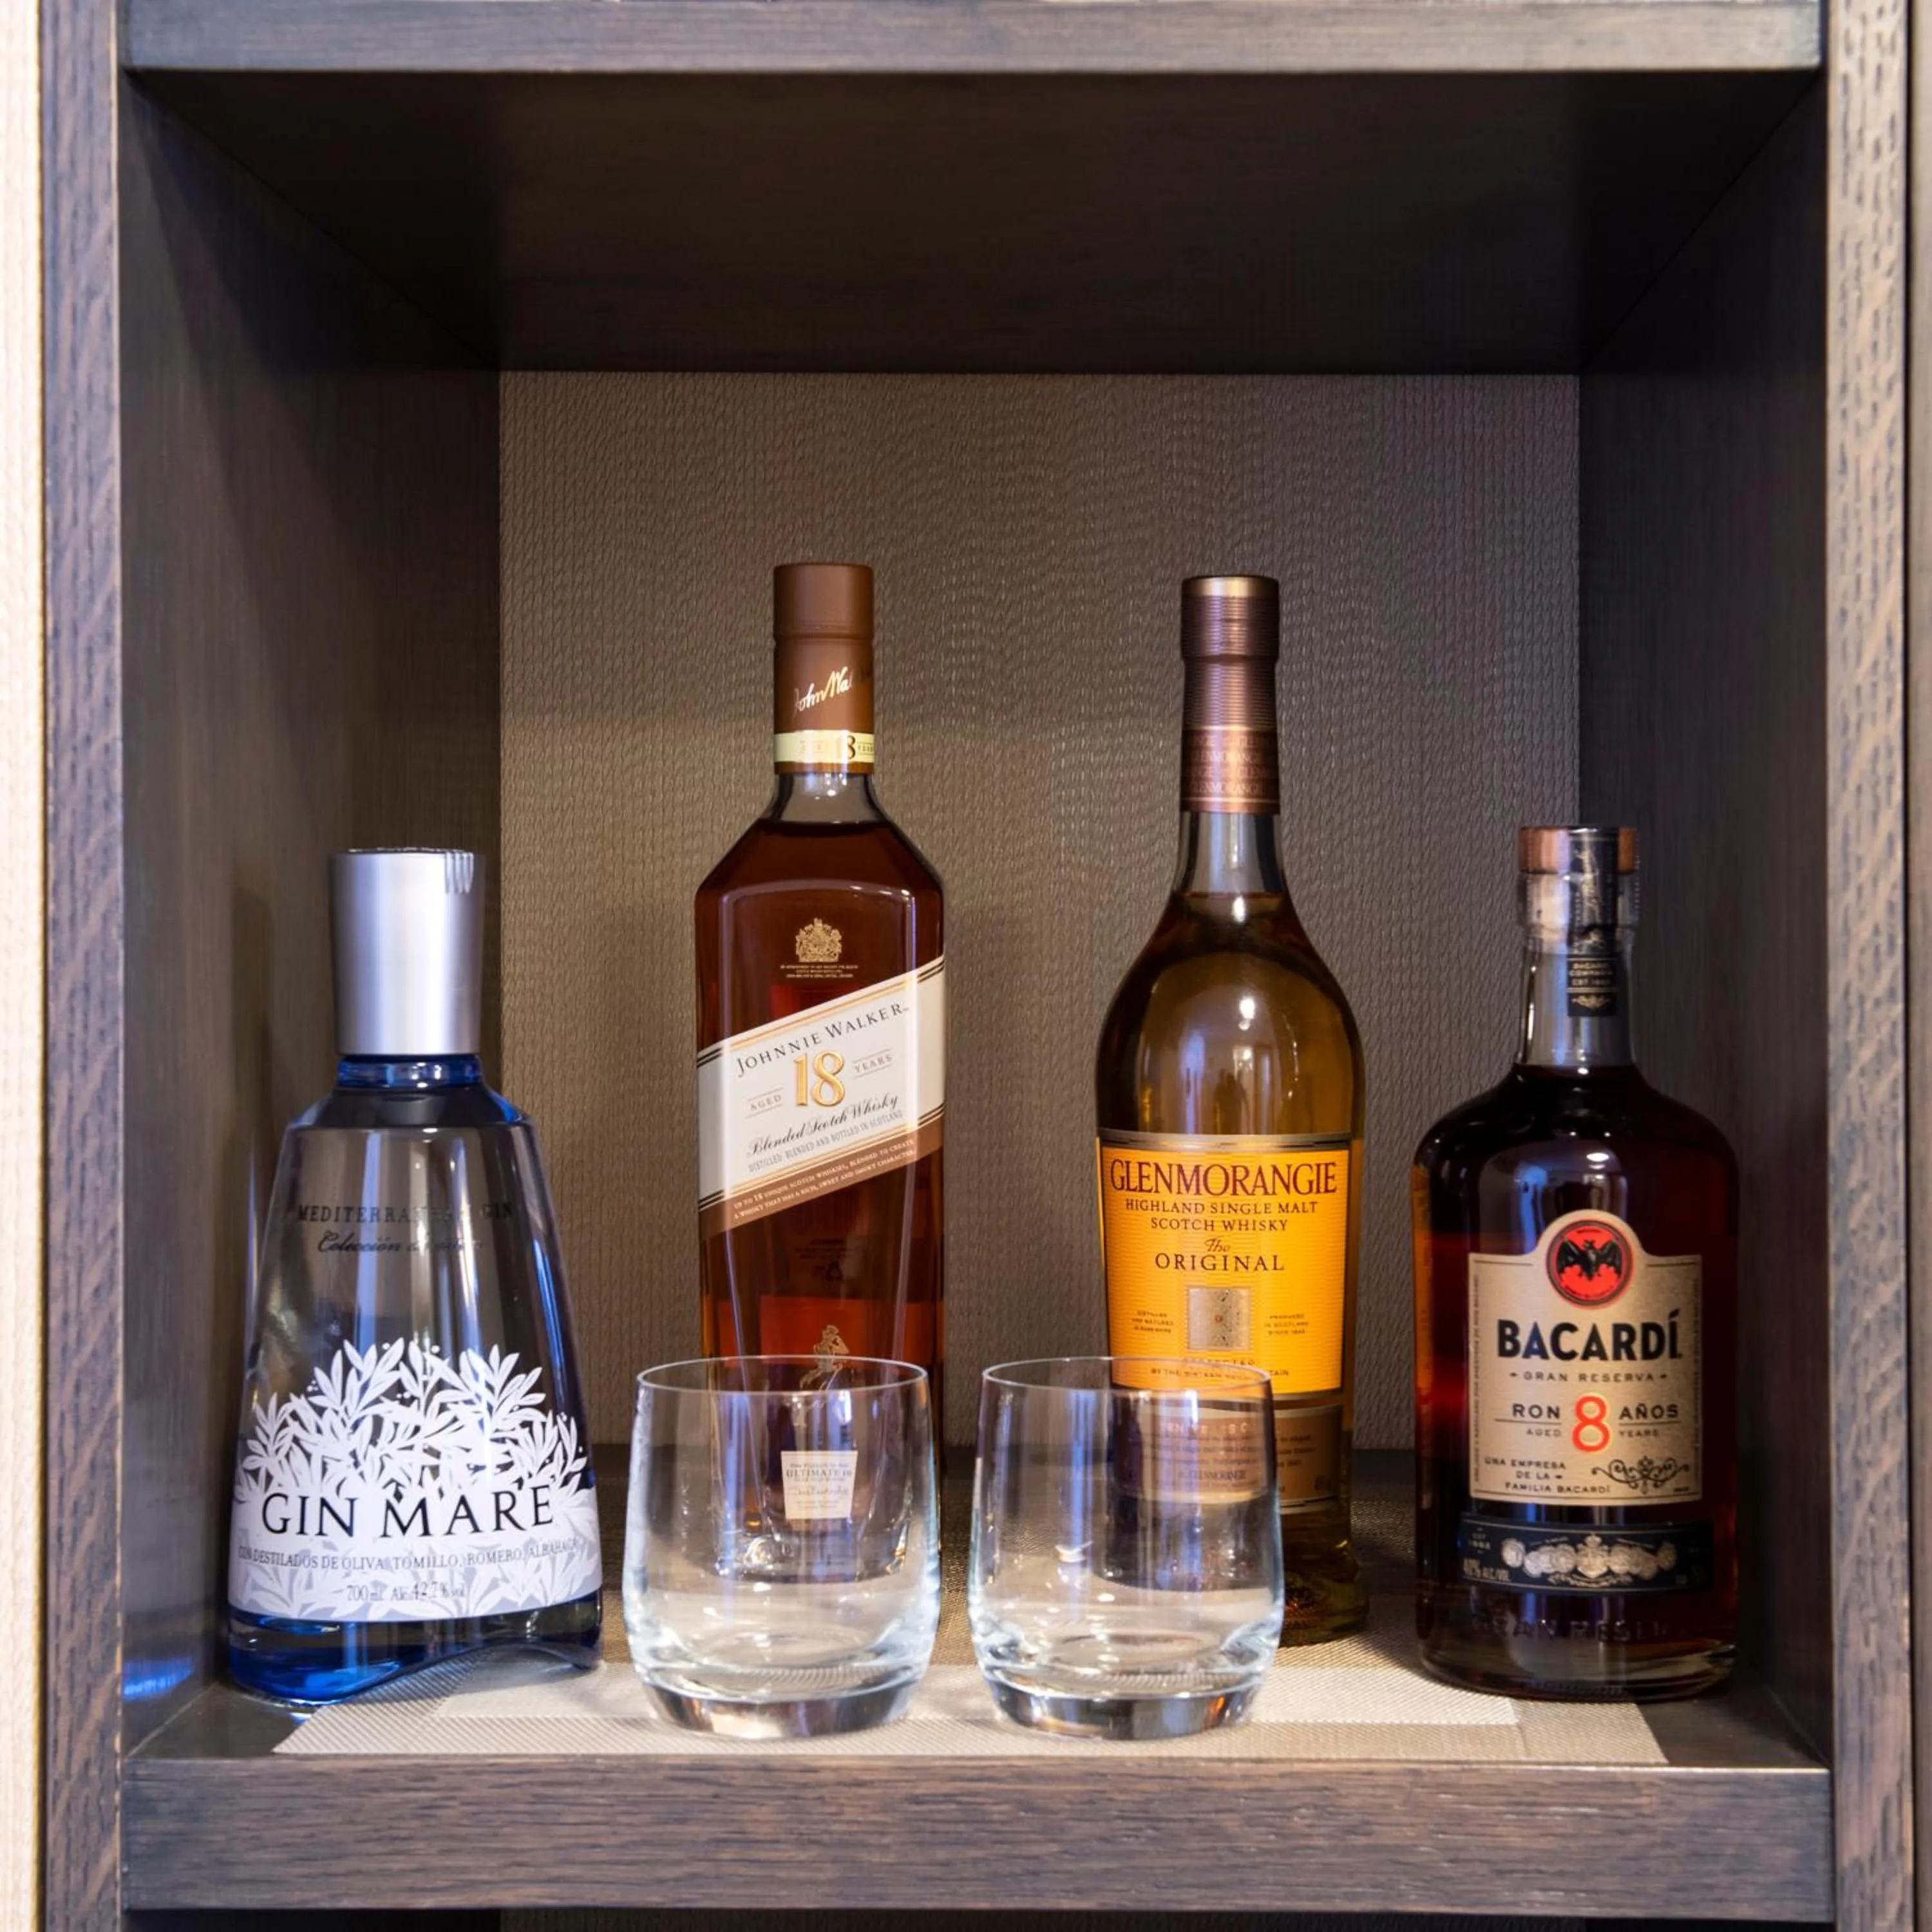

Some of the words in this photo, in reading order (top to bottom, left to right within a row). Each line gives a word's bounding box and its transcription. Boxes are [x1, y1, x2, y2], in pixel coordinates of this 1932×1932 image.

[737, 1032, 822, 1079] JOHNNIE
[824, 1002, 904, 1039] WALKER
[749, 1094, 782, 1113] AGED
[793, 1050, 846, 1108] 18
[854, 1054, 893, 1074] YEARS
[746, 1123, 806, 1158] Blended
[806, 1110, 848, 1137] Scotch
[846, 1092, 900, 1120] Whisky
[1110, 1158, 1338, 1197] GLENMORANGIE
[1125, 1198, 1206, 1215] HIGHLAND
[1209, 1202, 1273, 1215] SINGLE
[1277, 1200, 1319, 1215] MALT
[1150, 1217, 1216, 1232] SCOTCH
[1222, 1218, 1289, 1232] WHISKY
[1204, 1238, 1231, 1253] The
[1155, 1252, 1286, 1271] ORIGINAL
[1497, 1309, 1683, 1361] BACARDÍ
[1523, 1371, 1569, 1382] GRAN
[1578, 1372, 1654, 1383] RESERVA
[1512, 1403, 1561, 1420] RON
[1571, 1394, 1611, 1453] 8
[1618, 1402, 1680, 1421] AÑOS
[1526, 1428, 1562, 1437] AGED
[1618, 1428, 1660, 1437] YEARS
[1484, 1456, 1506, 1466] UNA
[1510, 1459, 1566, 1470] EMPRESA
[1516, 1470, 1531, 1479] DE
[1536, 1472, 1551, 1481] LA
[1504, 1481, 1552, 1493] FAMILIA
[261, 1492, 359, 1538] GIN
[379, 1484, 554, 1539] MARE
[252, 1548, 319, 1569] DESTILADOS
[321, 1555, 339, 1570] DE
